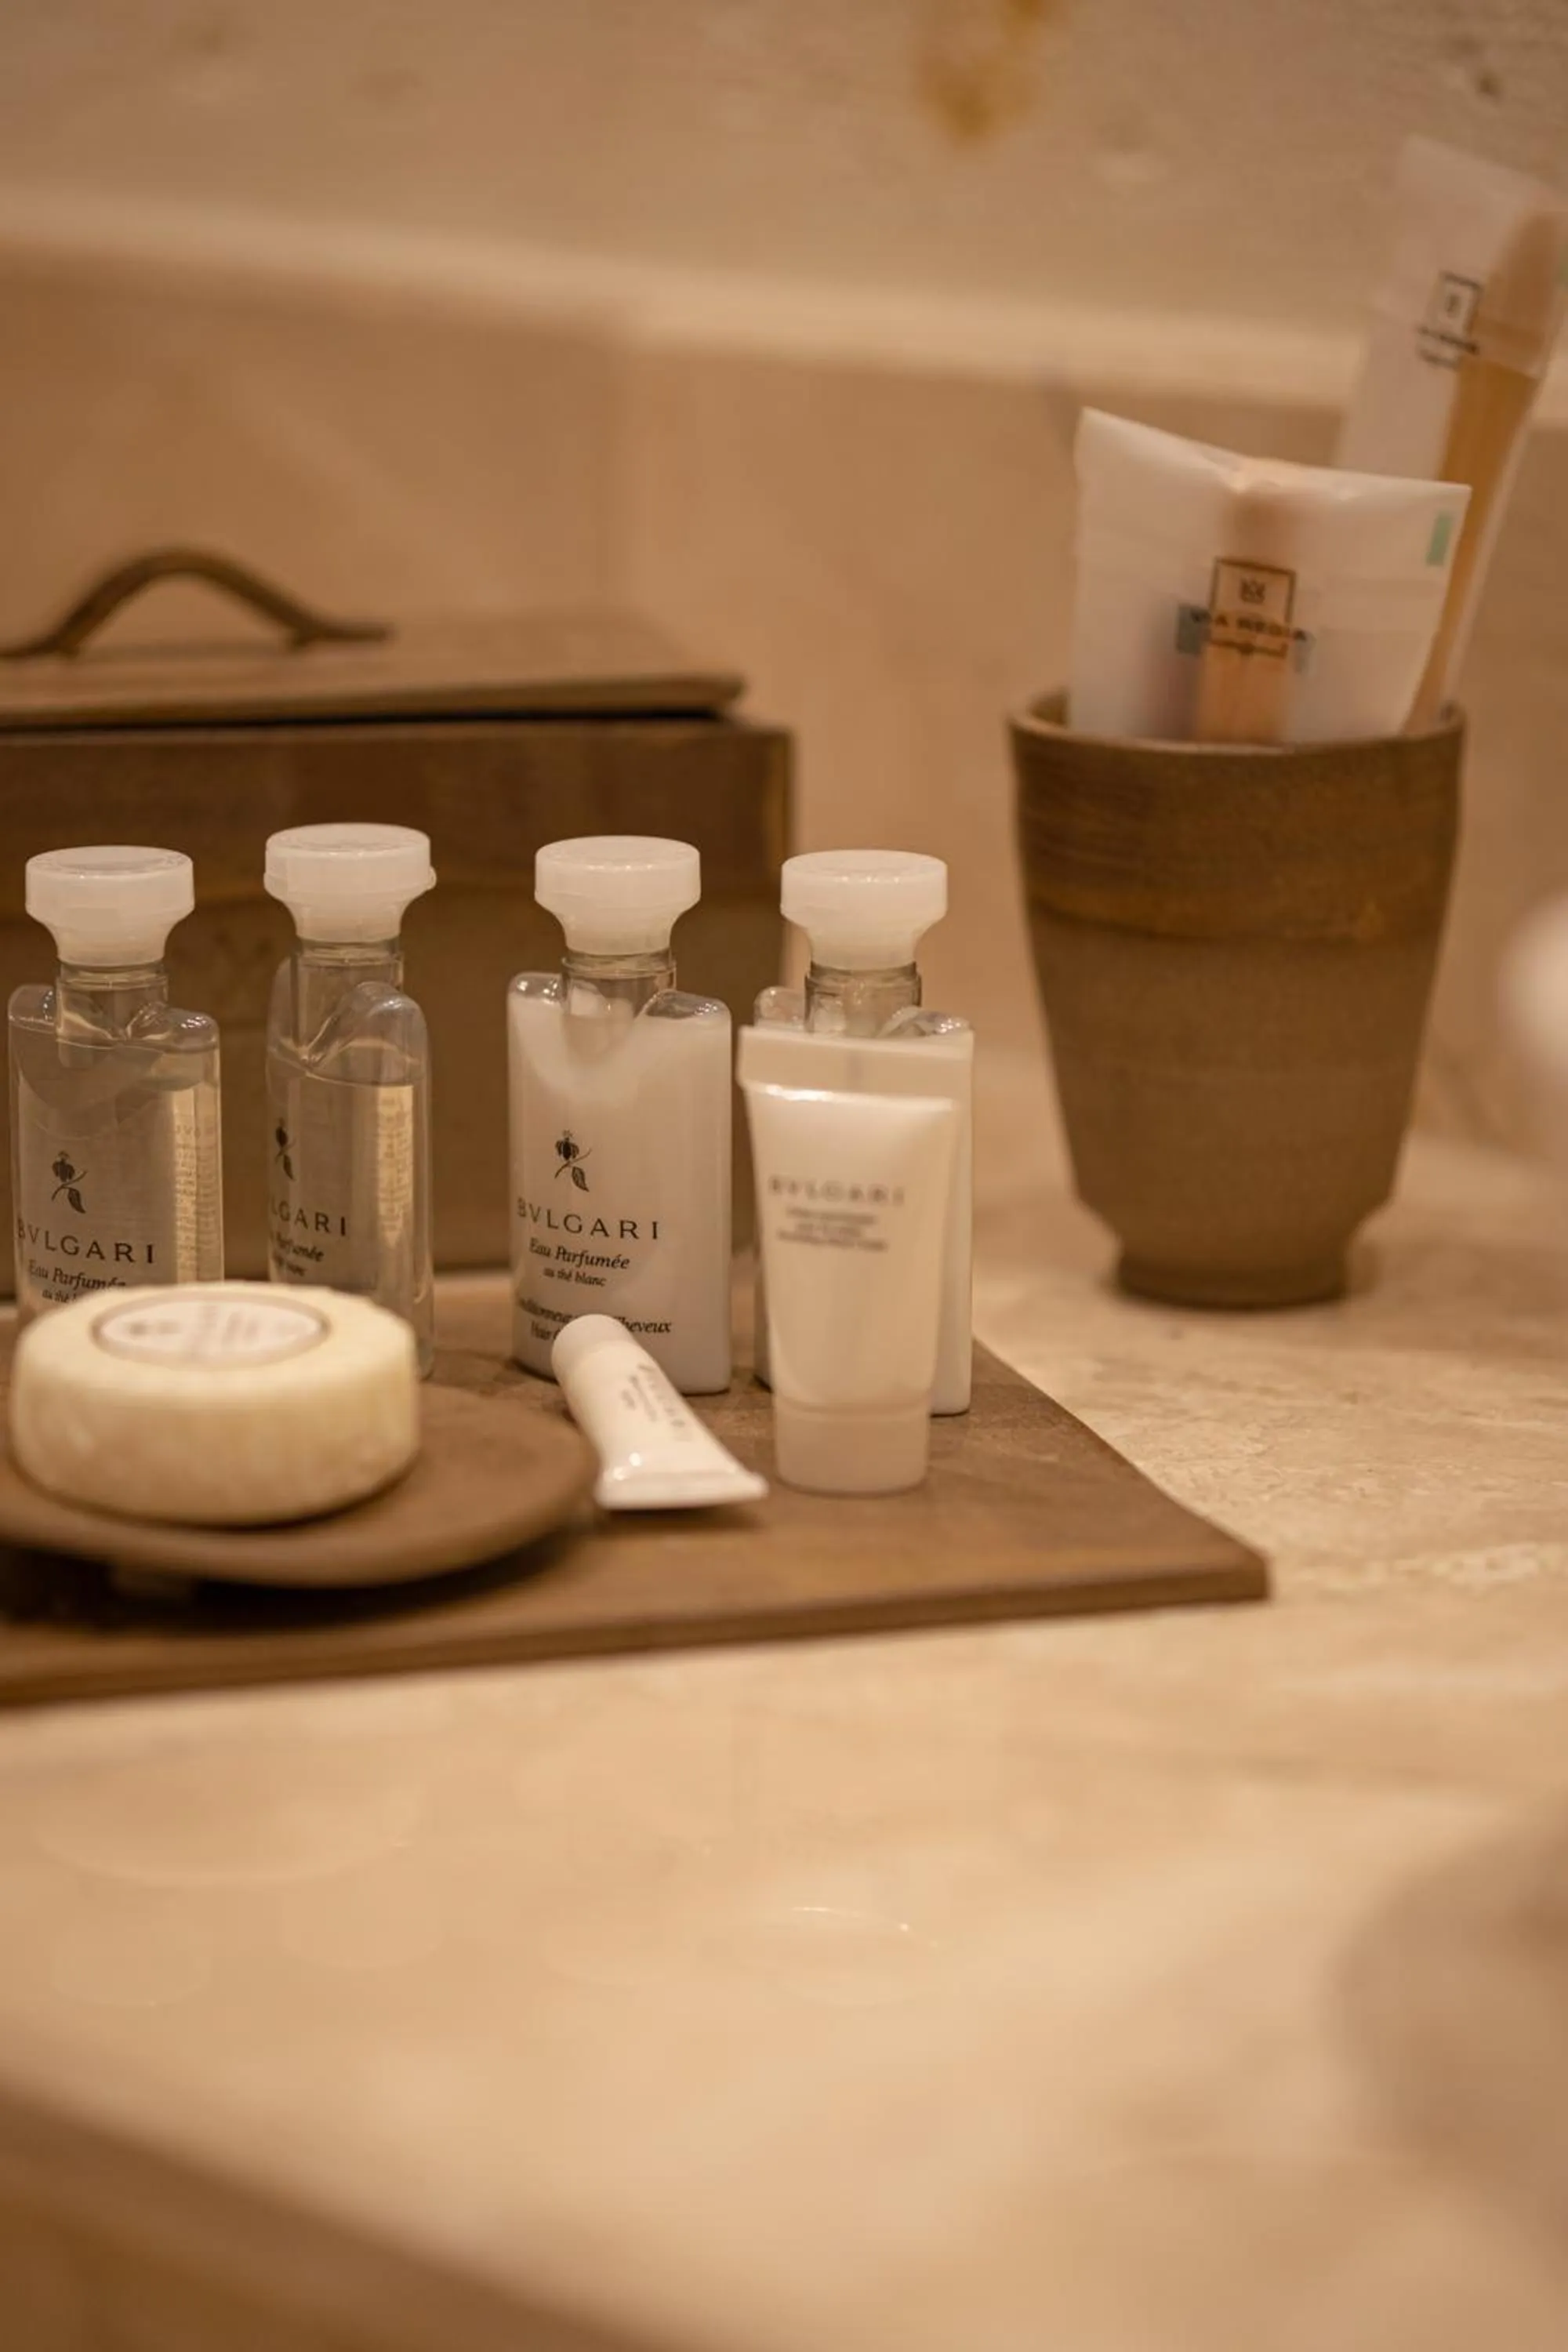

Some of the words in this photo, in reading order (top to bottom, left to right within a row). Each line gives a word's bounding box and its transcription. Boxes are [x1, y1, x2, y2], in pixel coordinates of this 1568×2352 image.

[516, 1196, 659, 1240] BVLGARI
[16, 1216, 154, 1264] BVLGARI
[529, 1237, 551, 1258] Eau
[555, 1245, 630, 1269] Parfumée
[29, 1258, 49, 1279] Eau
[575, 1270, 608, 1287] blanc
[613, 1316, 672, 1334] heveux
